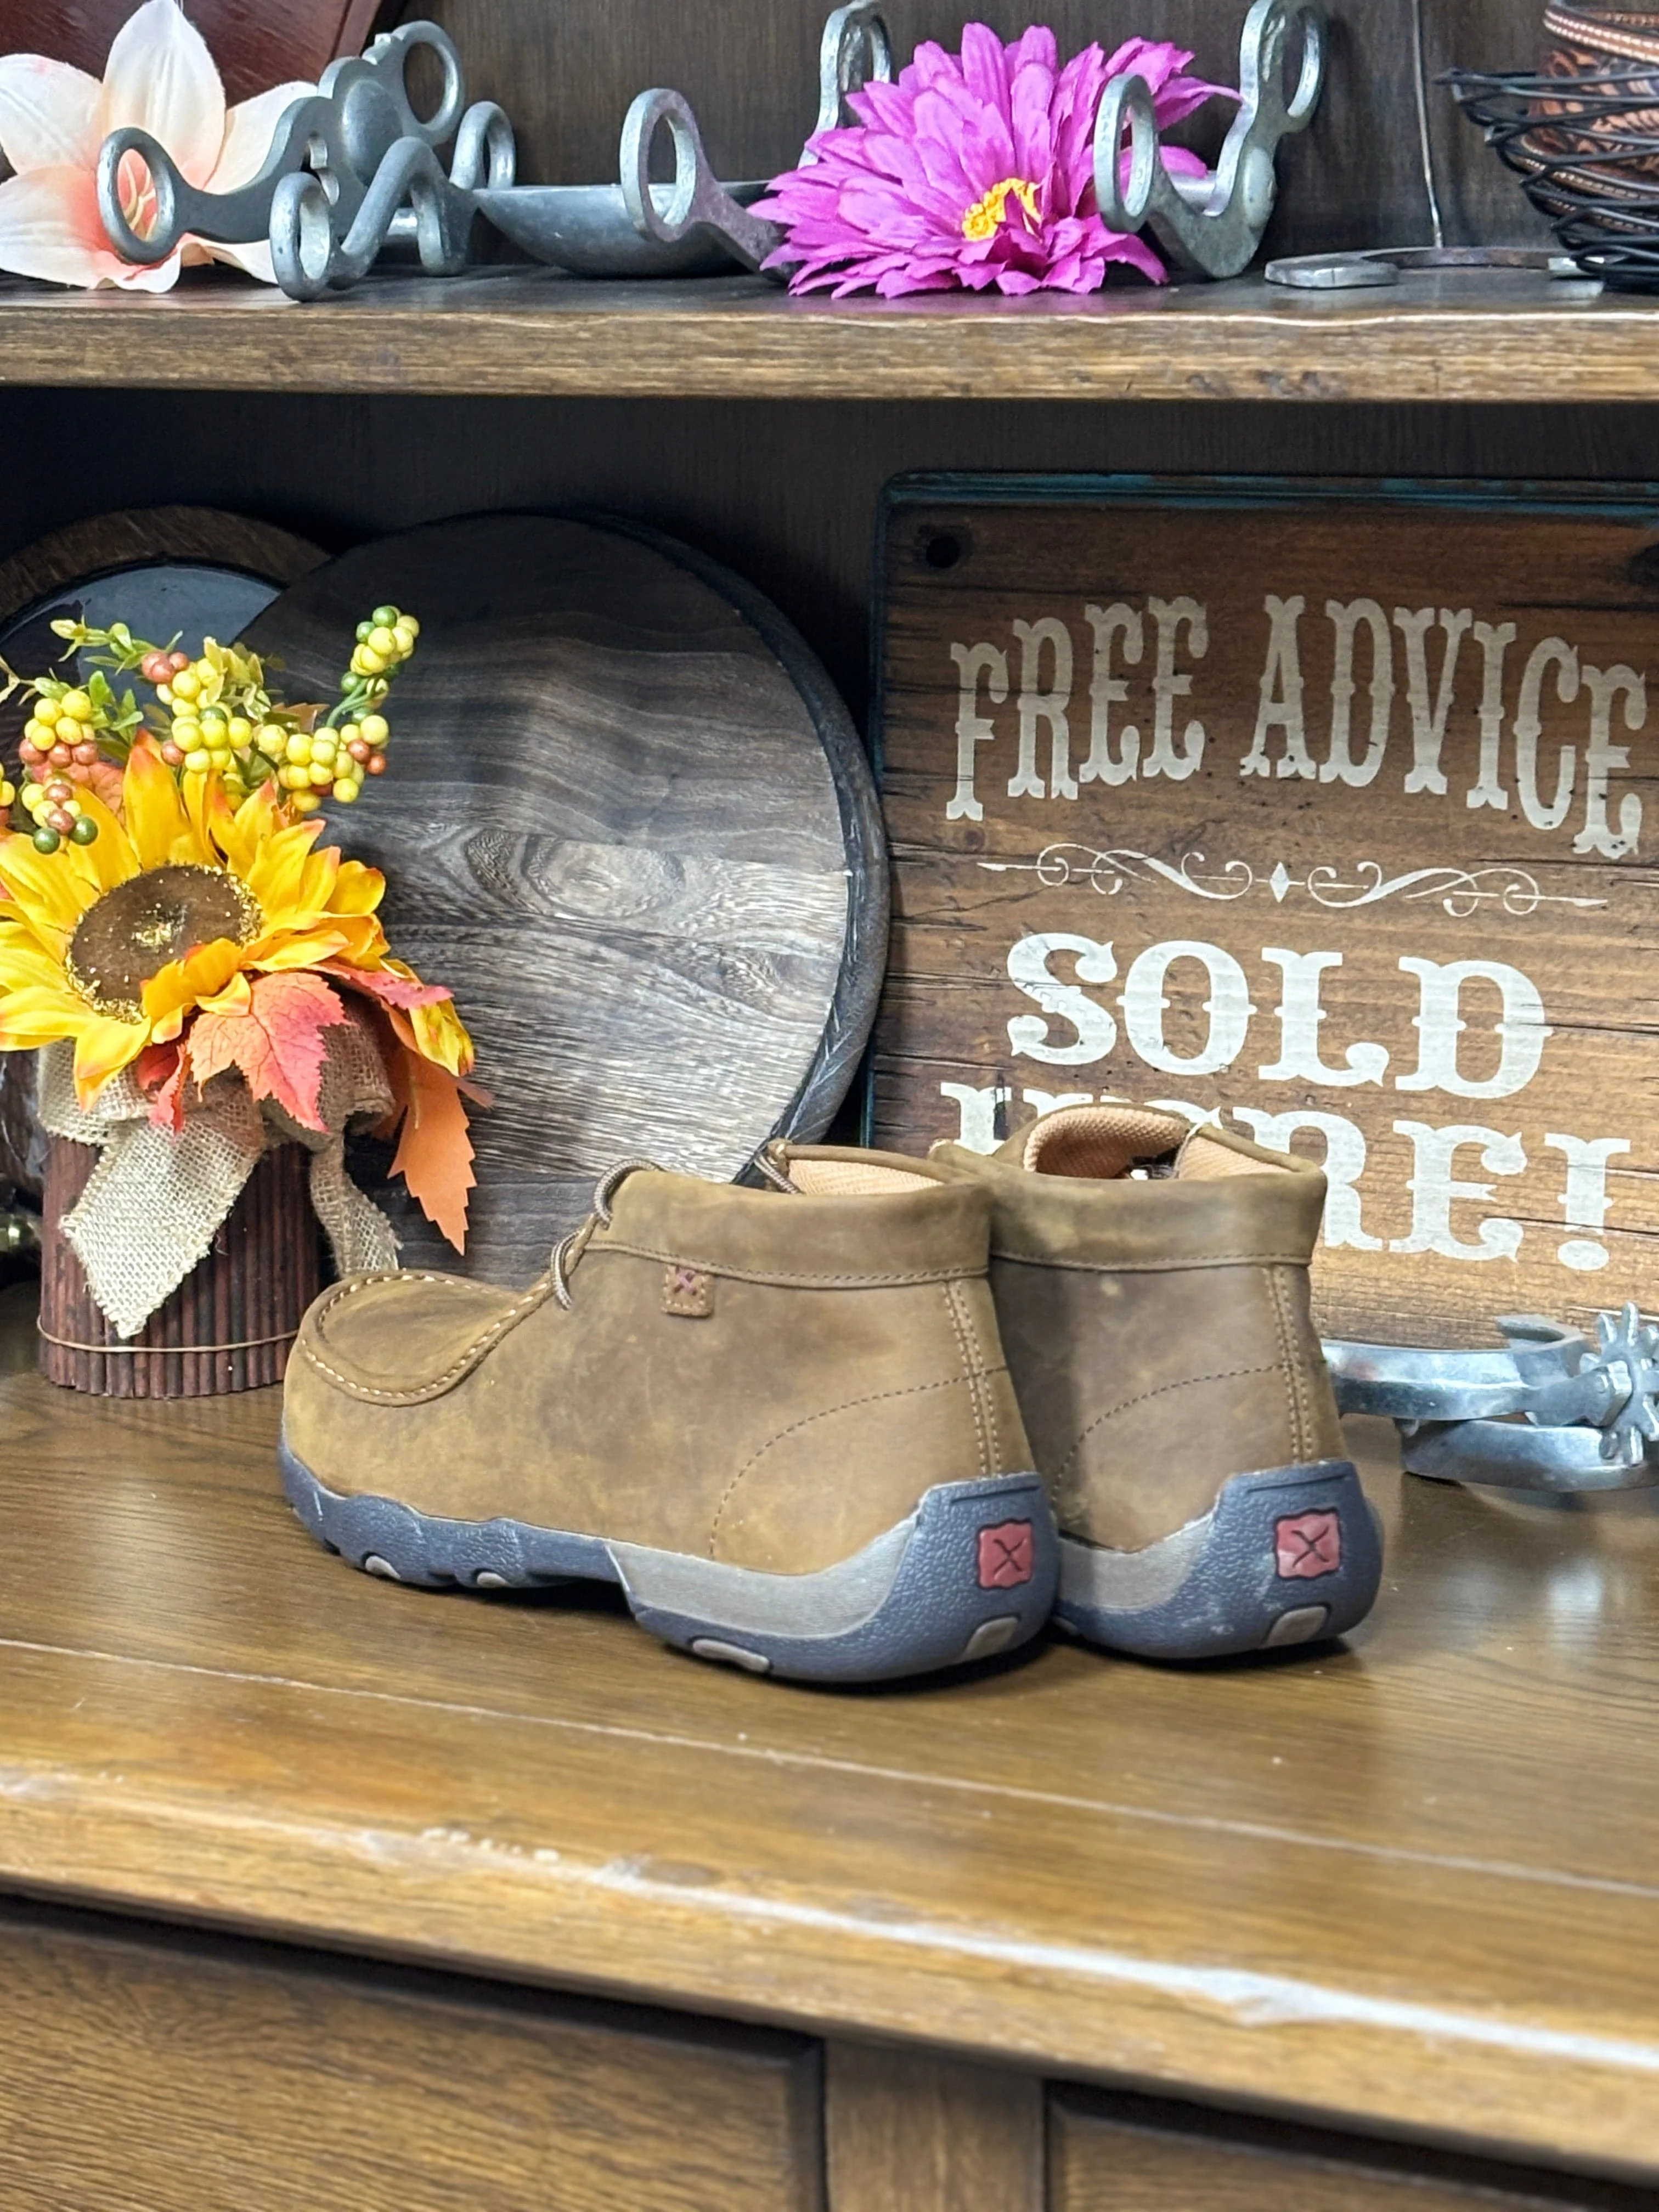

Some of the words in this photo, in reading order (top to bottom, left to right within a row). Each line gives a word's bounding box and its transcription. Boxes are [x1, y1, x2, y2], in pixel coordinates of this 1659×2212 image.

[947, 596, 1207, 821] FREE
[1240, 595, 1645, 857] ADVICE
[1007, 933, 1553, 1098] SOLD
[940, 1082, 1630, 1271] RE!
